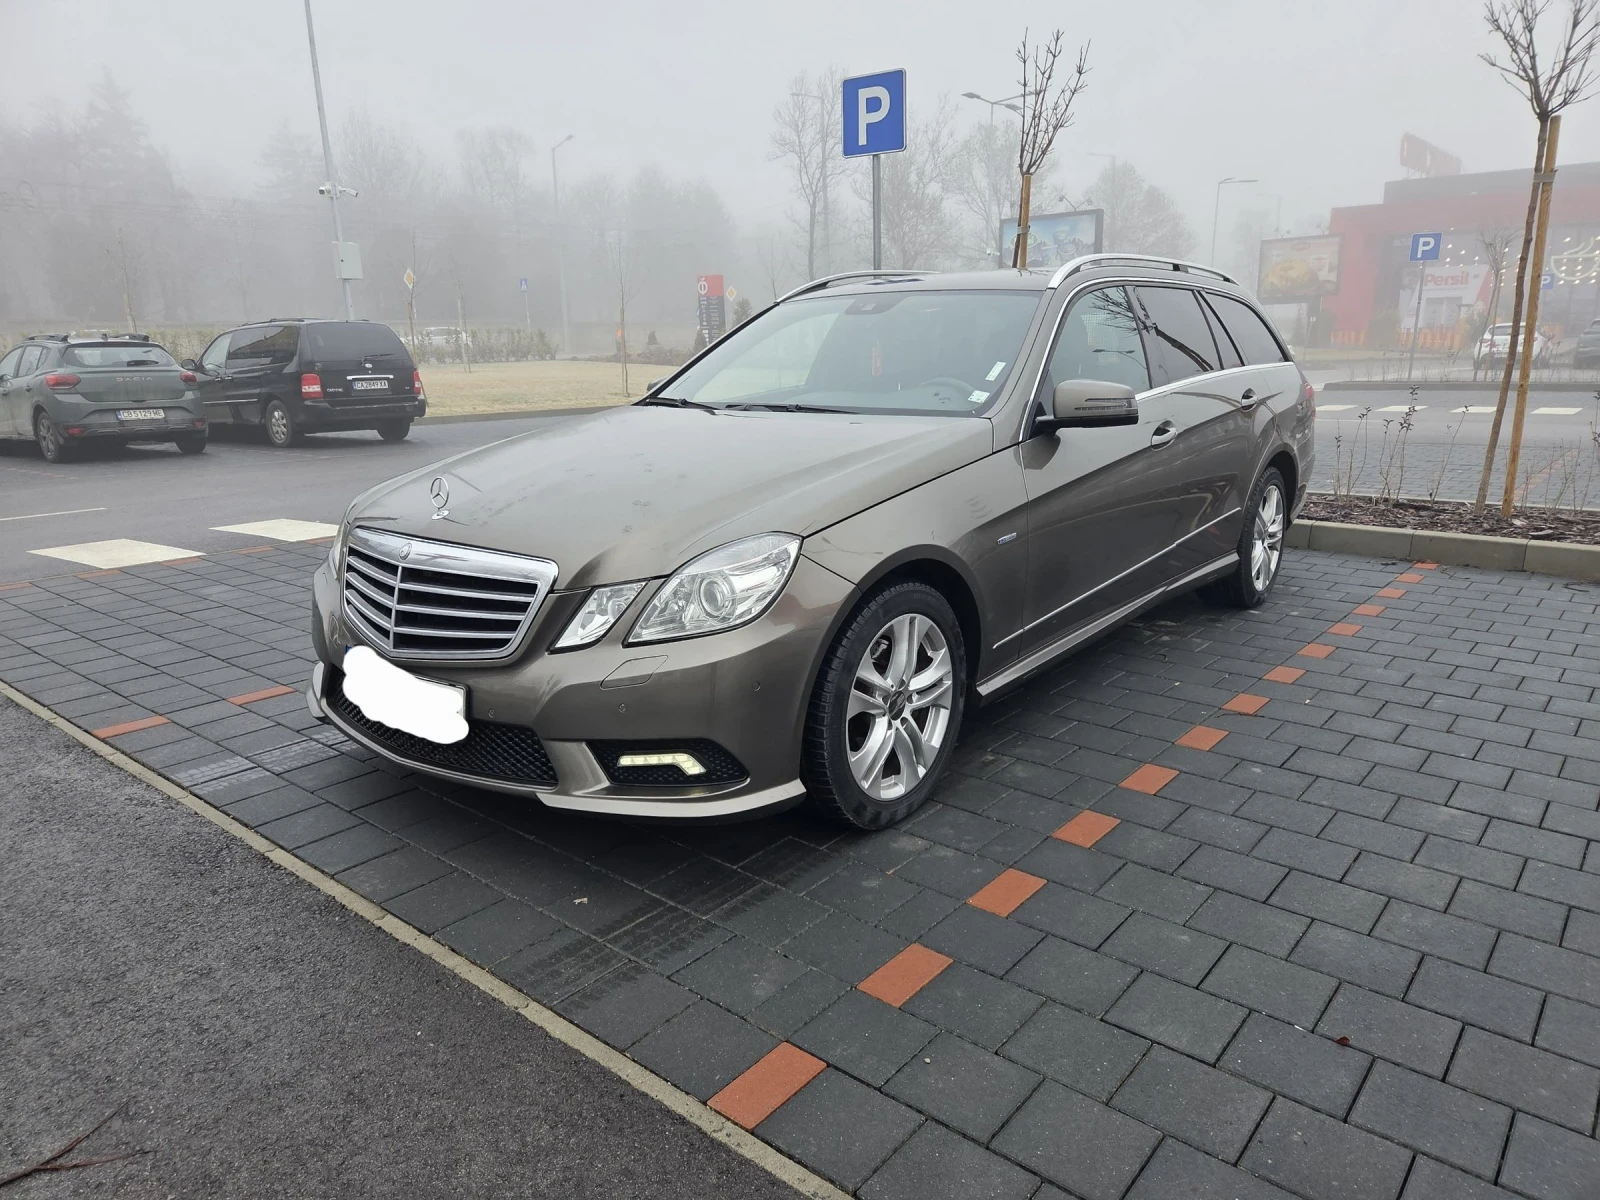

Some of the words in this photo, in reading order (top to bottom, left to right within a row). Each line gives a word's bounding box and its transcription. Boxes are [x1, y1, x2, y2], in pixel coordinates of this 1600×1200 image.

[857, 85, 891, 147] P
[1417, 237, 1435, 259] P
[1423, 271, 1470, 287] Persil
[1540, 275, 1552, 289] P
